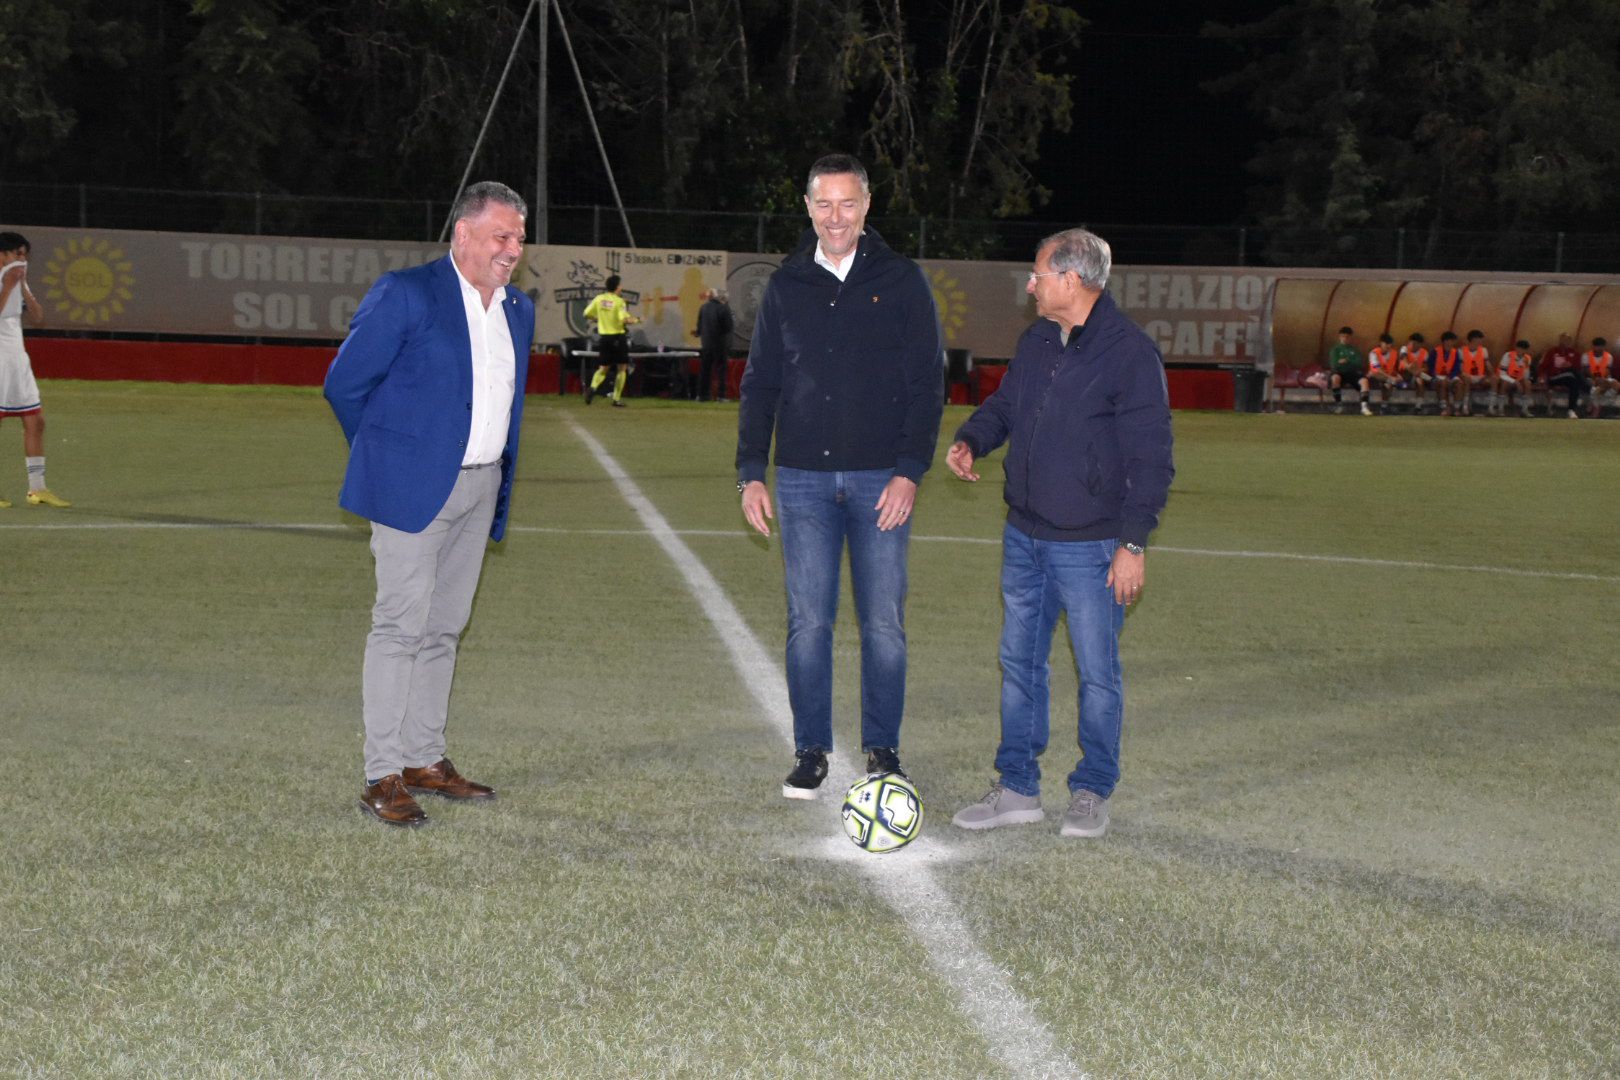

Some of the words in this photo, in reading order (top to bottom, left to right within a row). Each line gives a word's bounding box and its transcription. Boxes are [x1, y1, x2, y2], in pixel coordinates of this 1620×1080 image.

[667, 253, 722, 266] EDIZIONE
[69, 271, 108, 288] SOL
[233, 291, 318, 331] SOL
